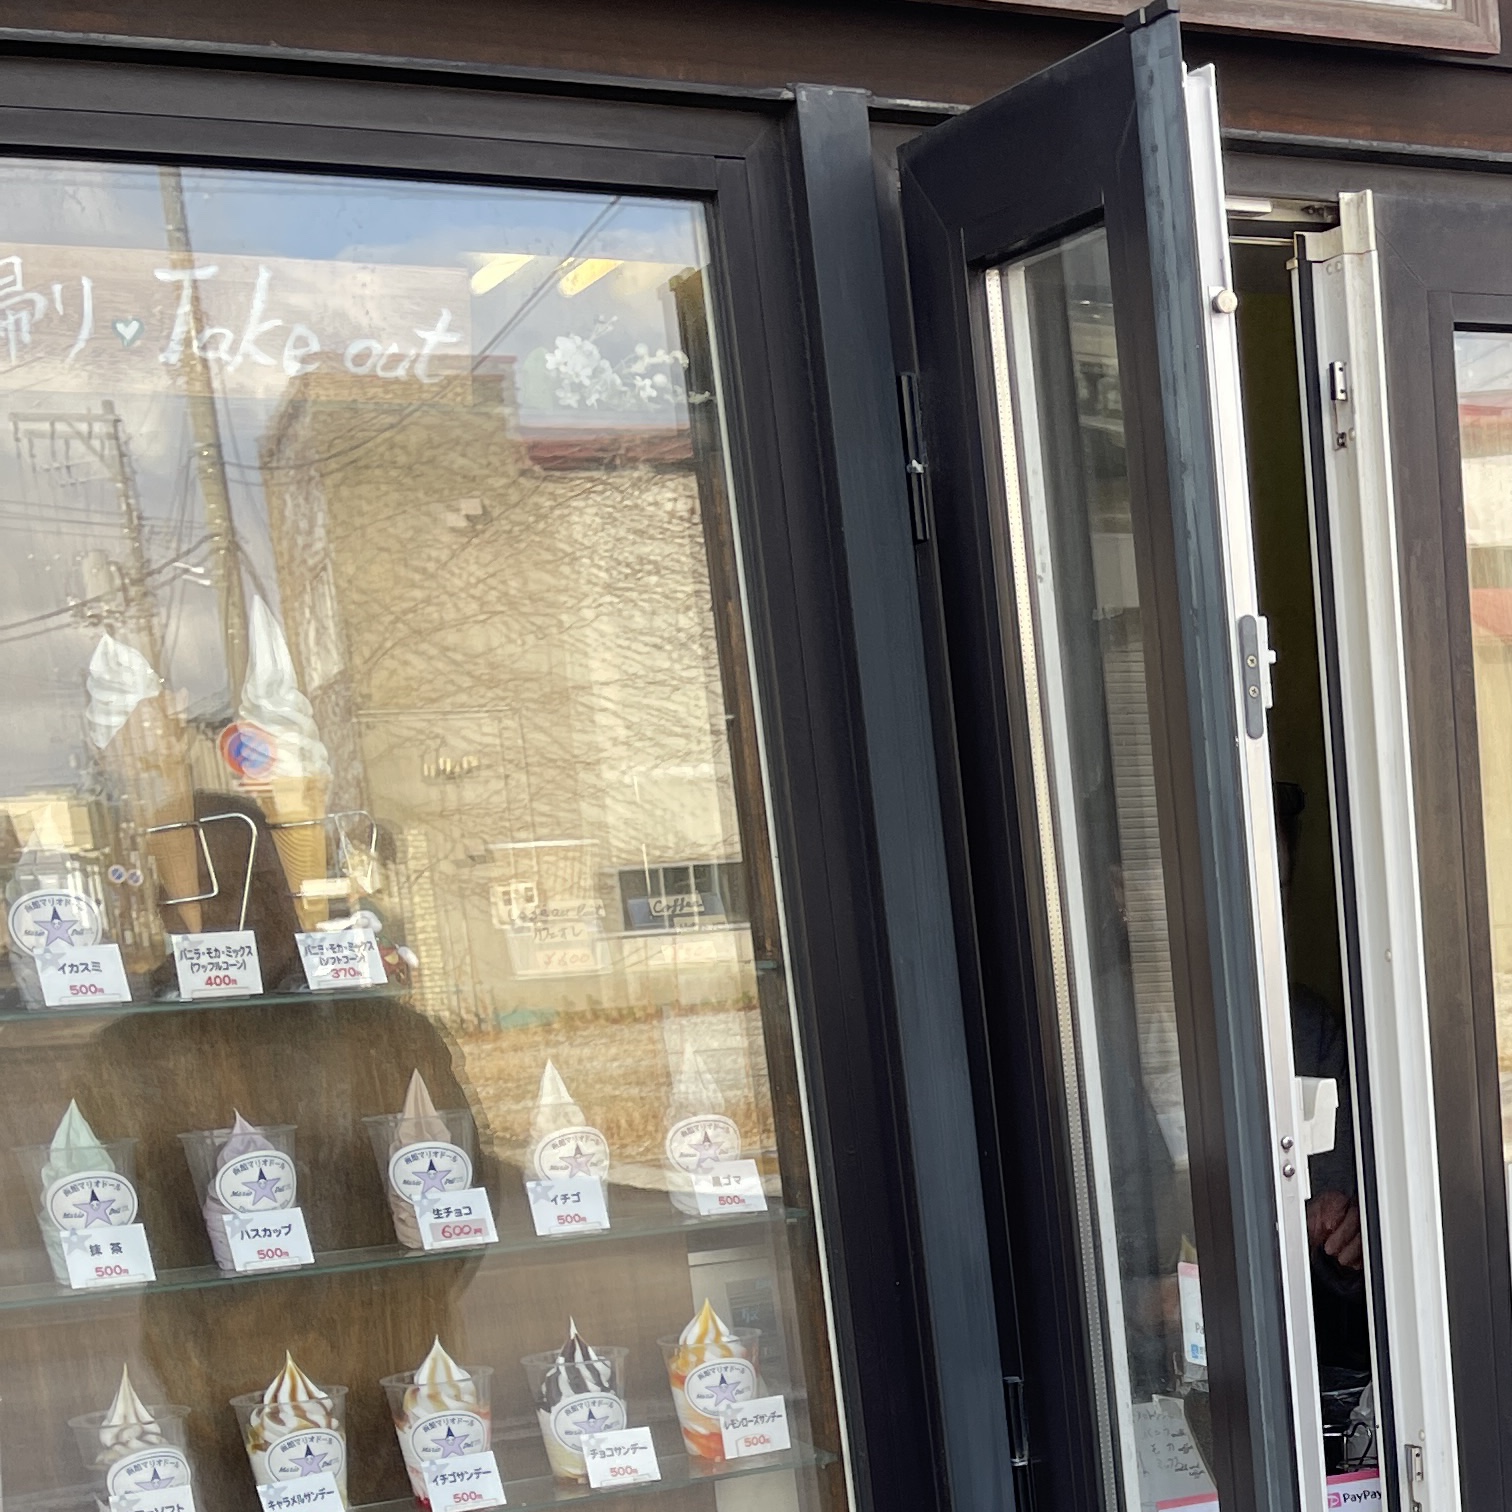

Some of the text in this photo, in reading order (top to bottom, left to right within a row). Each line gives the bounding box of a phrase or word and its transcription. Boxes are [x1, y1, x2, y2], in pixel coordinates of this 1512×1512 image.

[154, 264, 321, 377] Take
[344, 308, 463, 383] out
[57, 961, 103, 974] イカスミ
[204, 974, 238, 986] 400円
[69, 984, 105, 995] 500円
[550, 1191, 581, 1206] イチゴ
[718, 1195, 746, 1206] 500円
[432, 1206, 473, 1220] 生チョコ
[556, 1213, 587, 1225] 500円
[240, 1224, 292, 1240] ハスカップ
[441, 1224, 483, 1239] 600円
[256, 1247, 289, 1260] 500円
[95, 1264, 129, 1277] 500円
[590, 1443, 648, 1460] チョコサンデー
[432, 1468, 492, 1486] イチゴサンデー
[609, 1467, 639, 1478] 500円
[453, 1491, 483, 1504] 500円
[1342, 1489, 1382, 1505] PayPay
